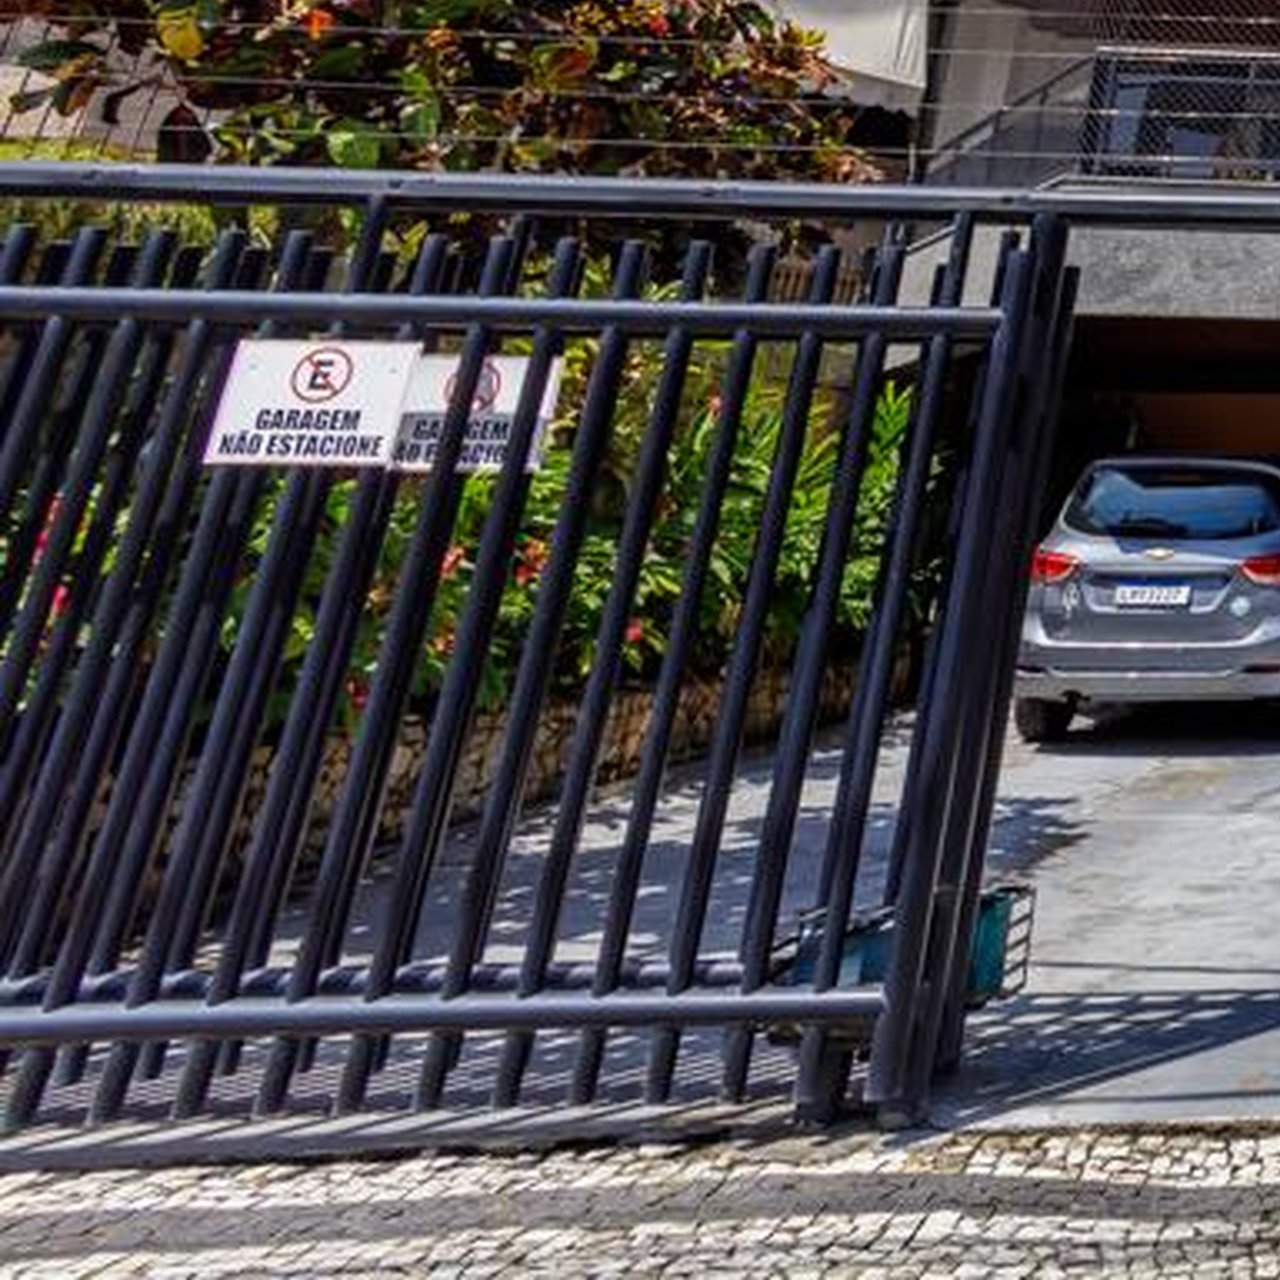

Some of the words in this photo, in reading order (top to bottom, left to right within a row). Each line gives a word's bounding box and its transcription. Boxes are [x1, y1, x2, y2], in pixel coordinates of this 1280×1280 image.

[254, 409, 362, 431] GARAGEM
[218, 431, 261, 456] NÃO
[264, 434, 386, 458] ESTACIONE
